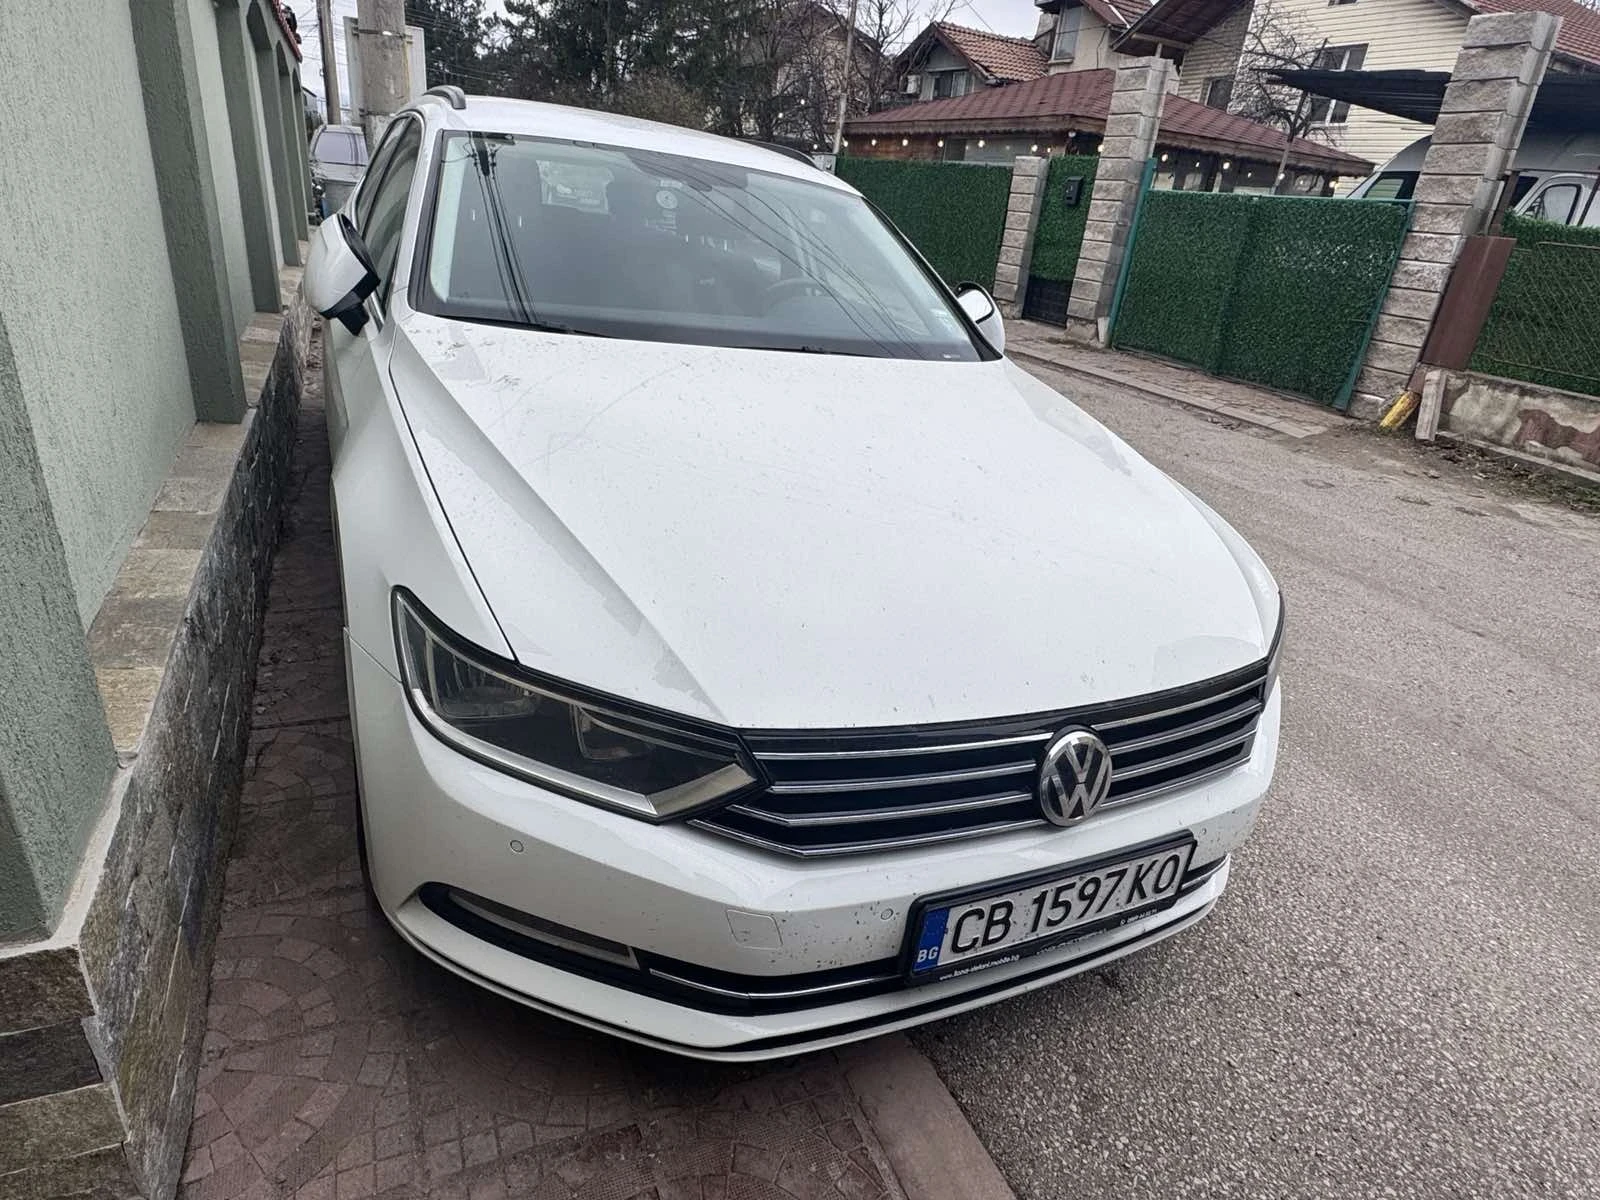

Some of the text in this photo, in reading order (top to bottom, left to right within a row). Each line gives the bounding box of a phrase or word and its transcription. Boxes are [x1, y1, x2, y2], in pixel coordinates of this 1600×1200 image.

[1042, 732, 1111, 824] VW
[951, 899, 1013, 954] CB
[1031, 868, 1127, 933] 1597
[1127, 854, 1180, 903] KO
[917, 946, 939, 963] BG
